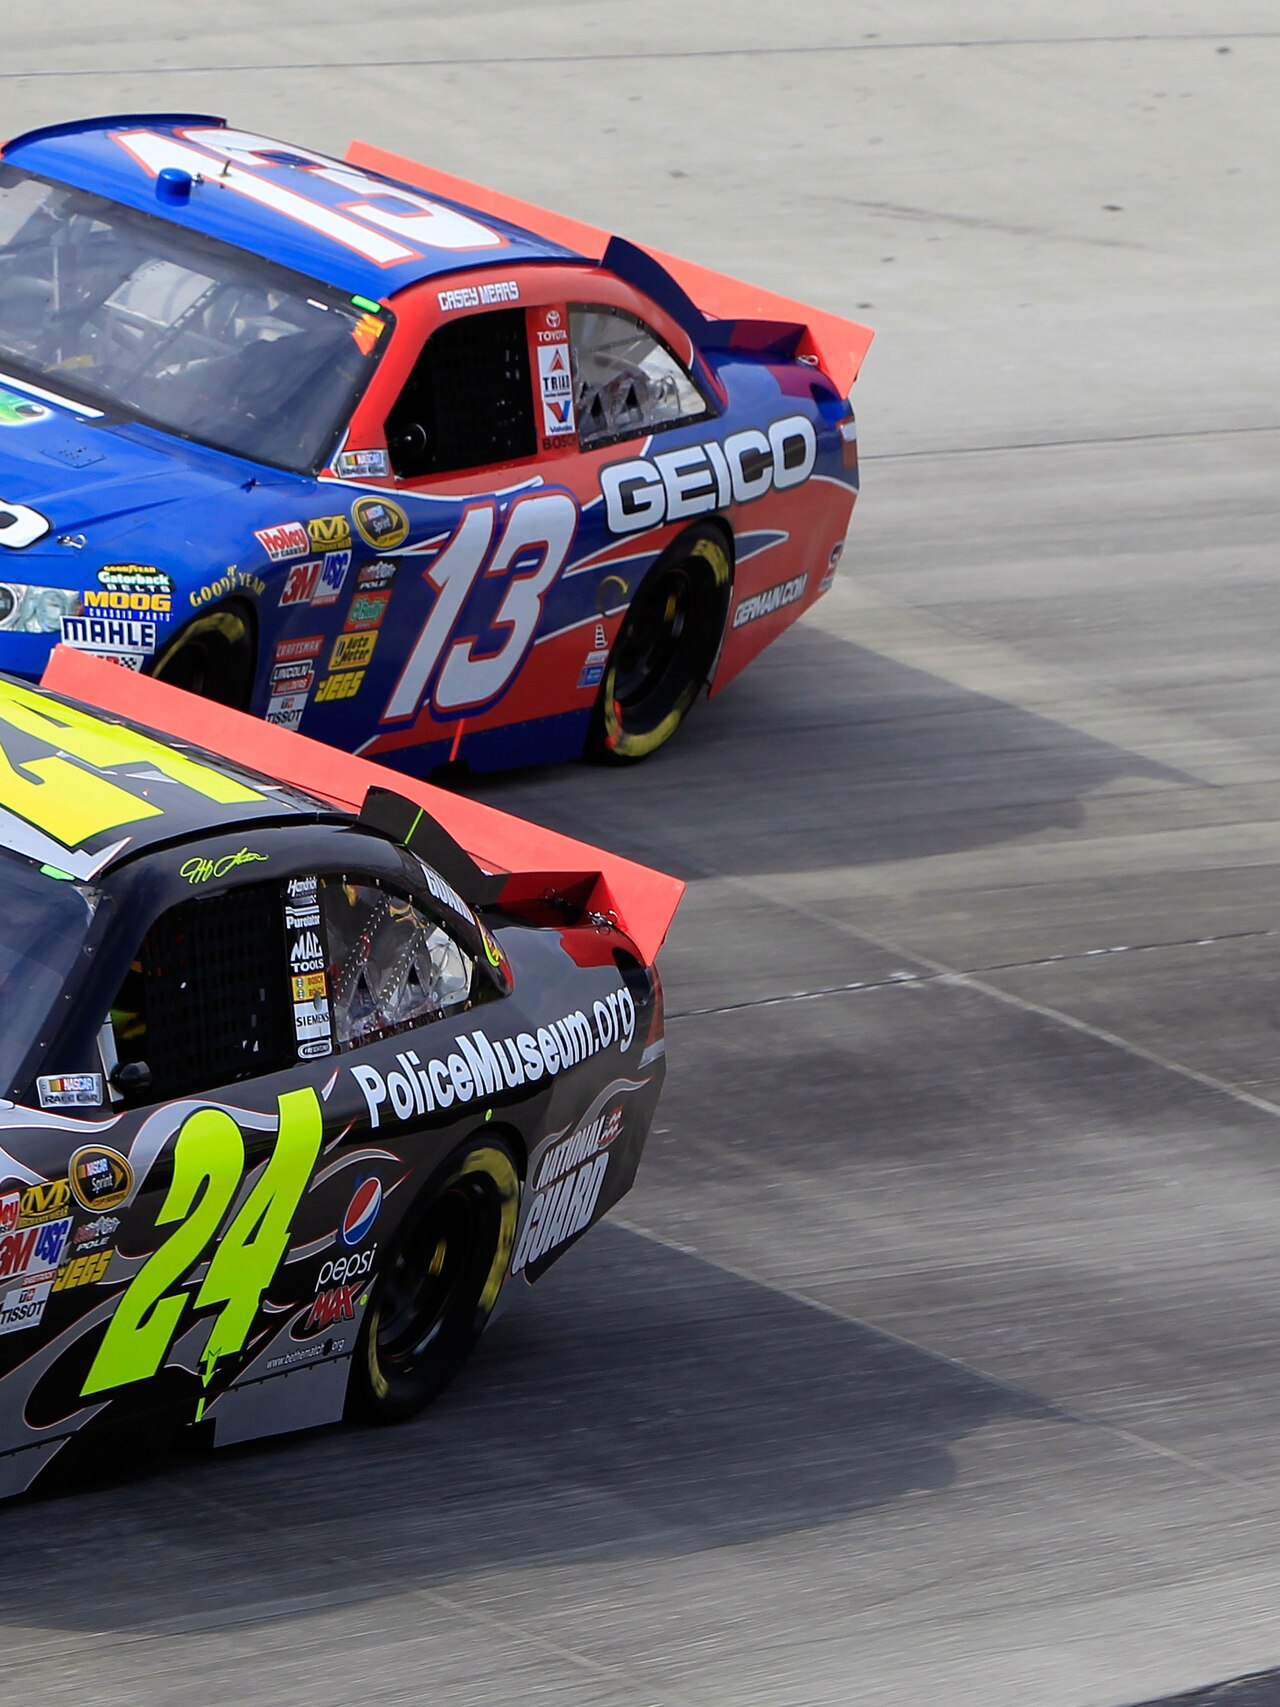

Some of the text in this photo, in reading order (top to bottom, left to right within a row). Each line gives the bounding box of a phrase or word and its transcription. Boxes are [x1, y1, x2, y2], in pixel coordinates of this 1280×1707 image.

[438, 281, 520, 311] CASEY MEARS
[536, 330, 568, 342] TOYOTA
[600, 415, 817, 534] GEICO
[258, 526, 308, 552] Holley
[98, 571, 170, 587] Gatorback
[282, 563, 322, 604] 3M
[322, 551, 350, 591] USG
[359, 580, 388, 590] POLE
[106, 584, 171, 593] BELTS
[189, 565, 267, 608] GOODYEAR
[733, 573, 808, 628] GERMAIN.COM
[84, 591, 171, 612] MOOG
[89, 608, 171, 623] CHASSIS PARTS
[383, 494, 578, 720] 13
[63, 618, 155, 648] MAHLE
[346, 635, 369, 650] Auto
[341, 649, 370, 662] Meter
[274, 664, 309, 681] LINCOLN
[314, 670, 366, 702] JEGS
[267, 708, 303, 724] TISSOT
[290, 958, 324, 972] TOOLS
[296, 1012, 329, 1027] SIEMENS
[350, 987, 636, 1129] PoliceMuseum.org
[63, 1077, 94, 1091] NASCAR
[536, 1113, 607, 1191] NATIONAL
[92, 1173, 114, 1193] Sprint
[511, 1151, 609, 1277] GUARD
[35, 1219, 70, 1265] USG
[76, 1236, 110, 1252] POLE
[79, 1086, 324, 1397] 24
[52, 1250, 114, 1293] JEGS
[315, 1242, 378, 1293] pepsi
[0, 1300, 46, 1325] TISSOT
[304, 1280, 366, 1330] MAX
